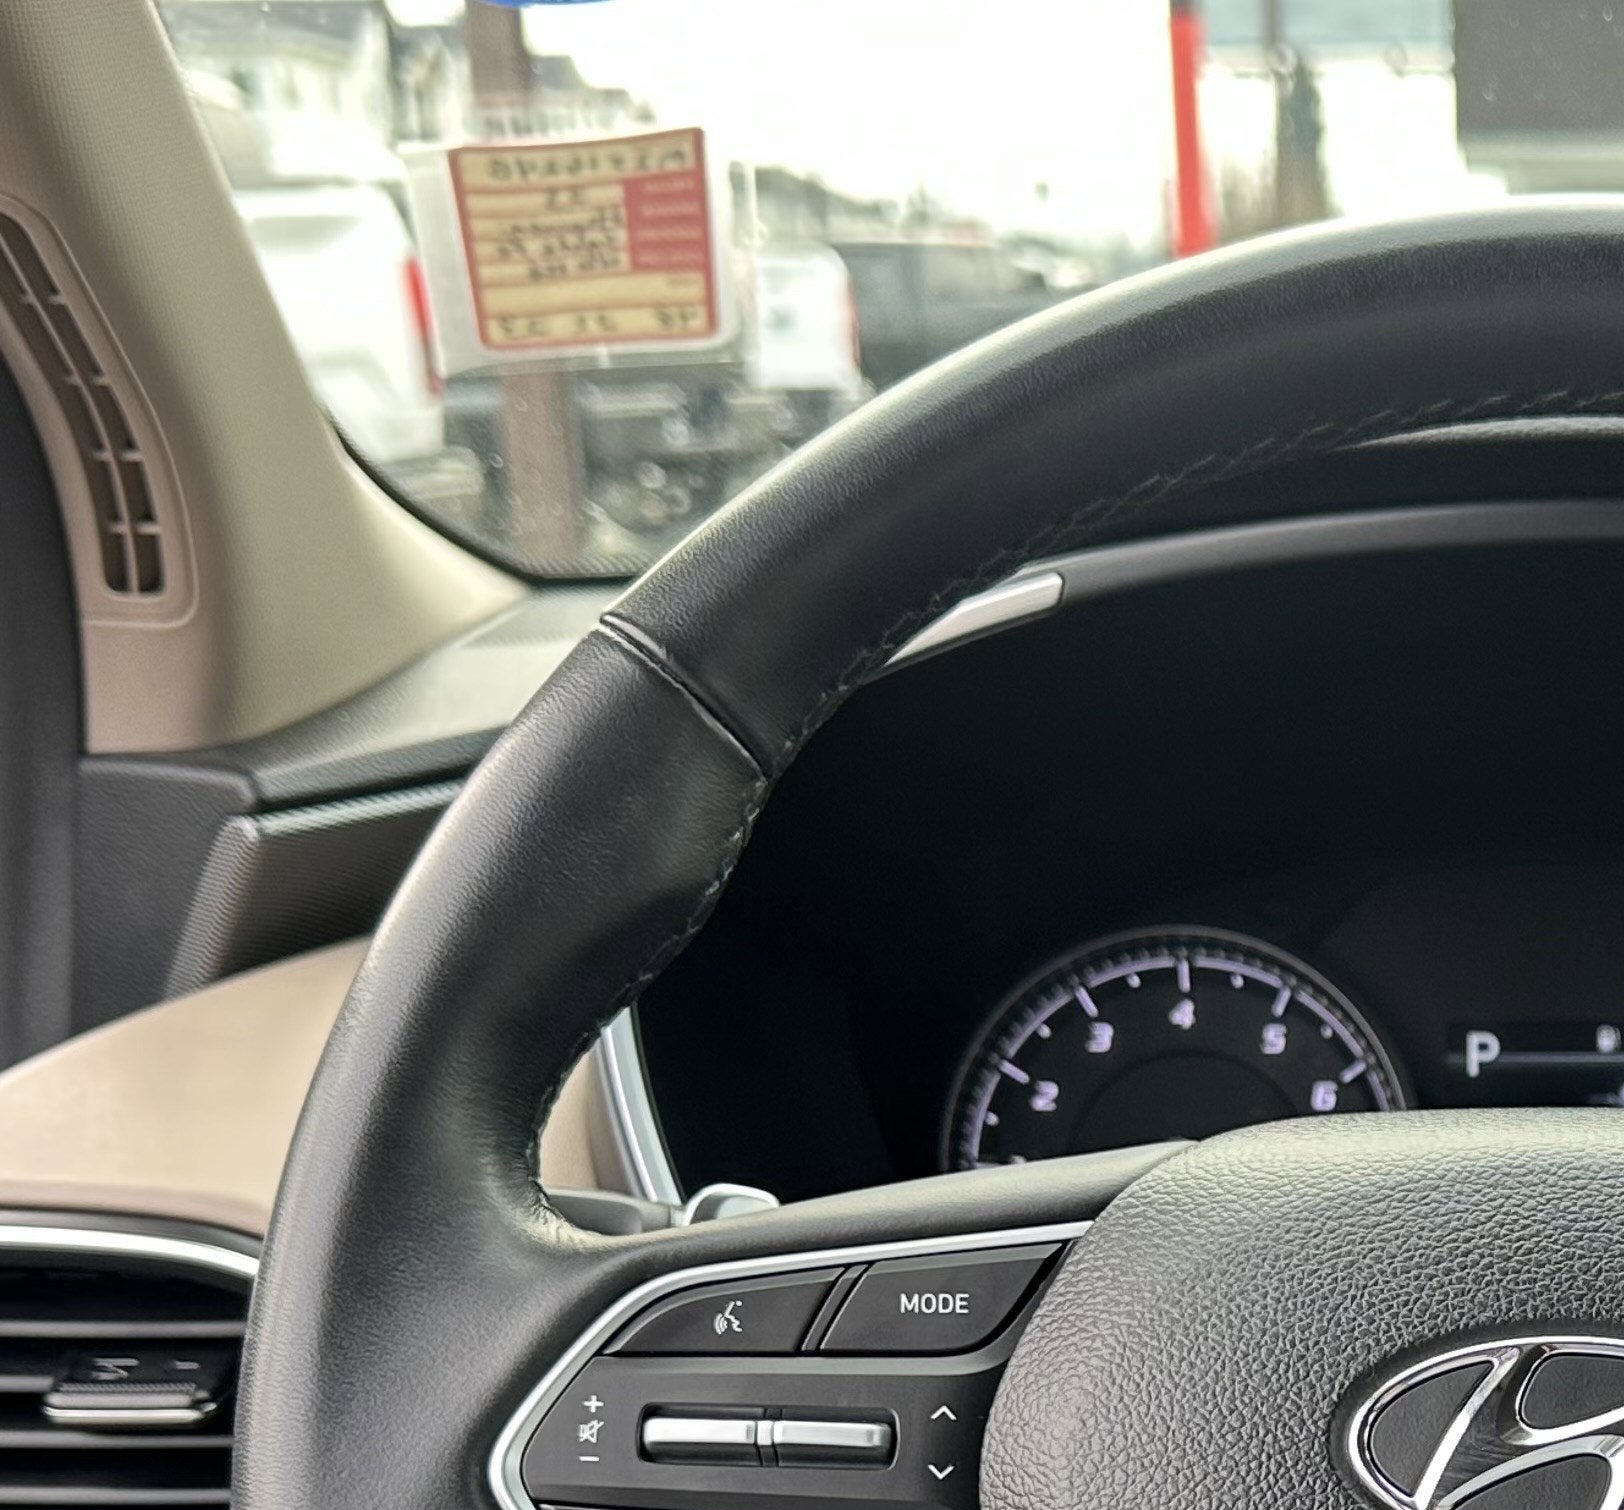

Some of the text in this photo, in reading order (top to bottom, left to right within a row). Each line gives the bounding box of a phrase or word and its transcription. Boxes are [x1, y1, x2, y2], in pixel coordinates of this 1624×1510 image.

[1169, 999, 1195, 1029] 4
[1086, 1022, 1114, 1053] 3
[1261, 1023, 1288, 1055] 5
[1467, 1031, 1501, 1078] P
[1031, 1080, 1059, 1111] 2
[1311, 1080, 1338, 1111] 6
[898, 1292, 970, 1315] MODE
